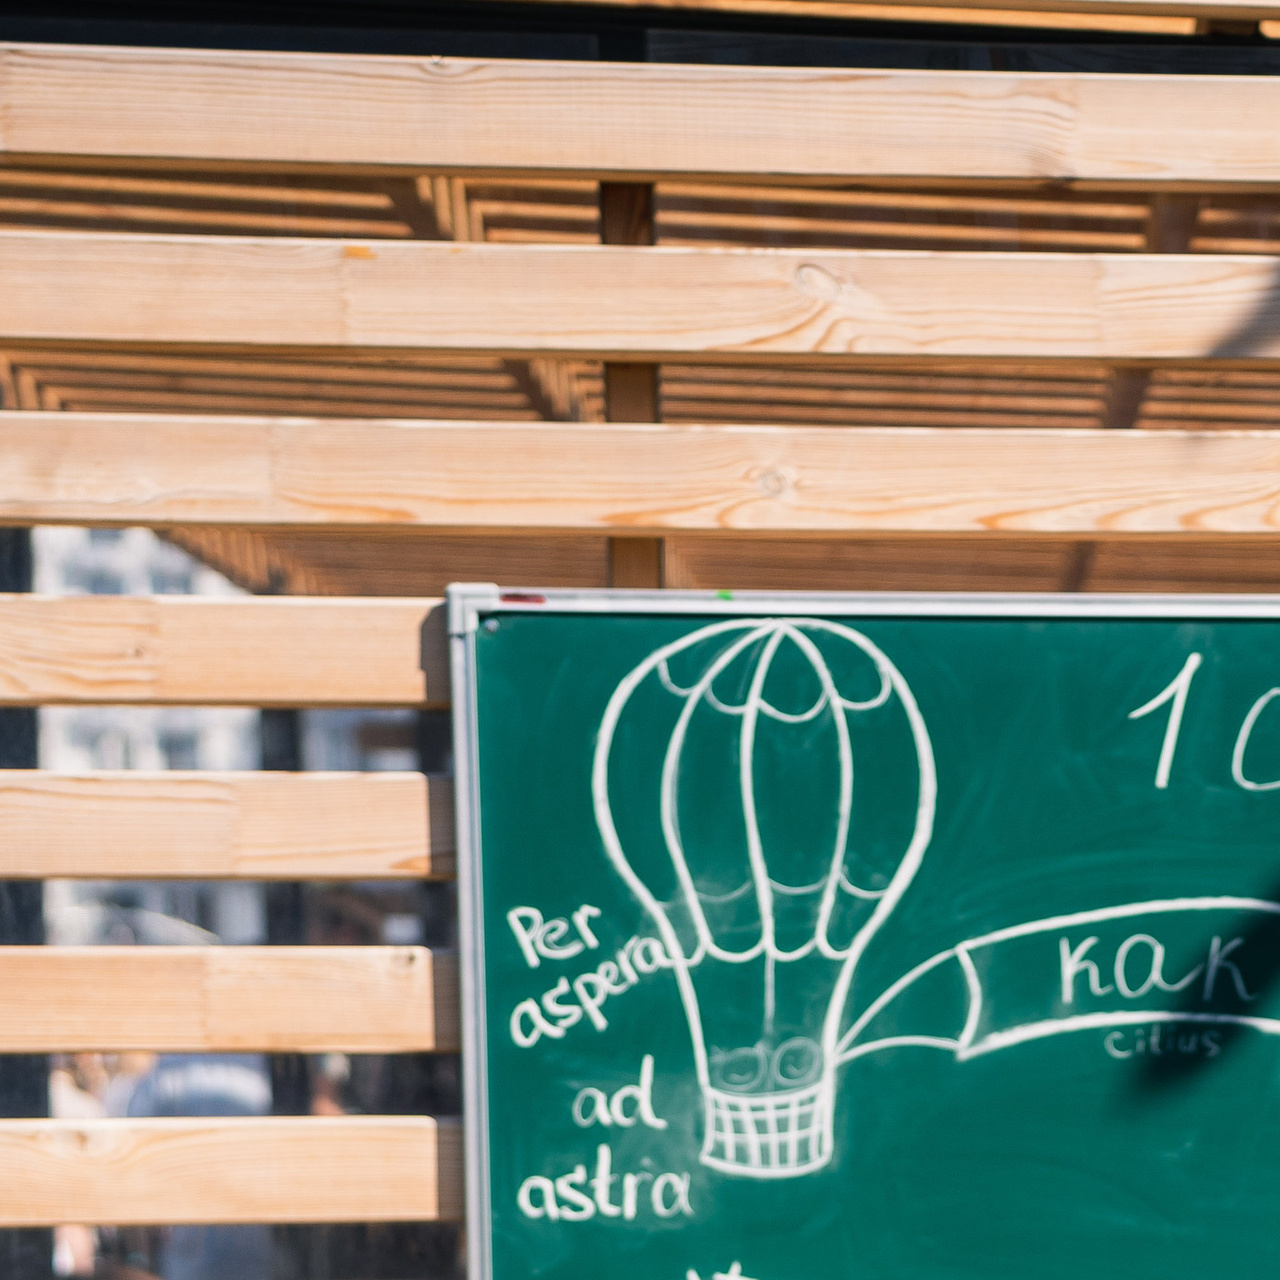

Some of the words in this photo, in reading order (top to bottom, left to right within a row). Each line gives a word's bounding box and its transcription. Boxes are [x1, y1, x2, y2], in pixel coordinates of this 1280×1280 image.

[1127, 652, 1202, 789] 1
[506, 903, 603, 969] Per
[1058, 933, 1257, 1005] как
[509, 934, 676, 1049] aspera
[1103, 1021, 1223, 1060] citius
[571, 1053, 669, 1130] ad
[516, 1142, 696, 1222] astra
